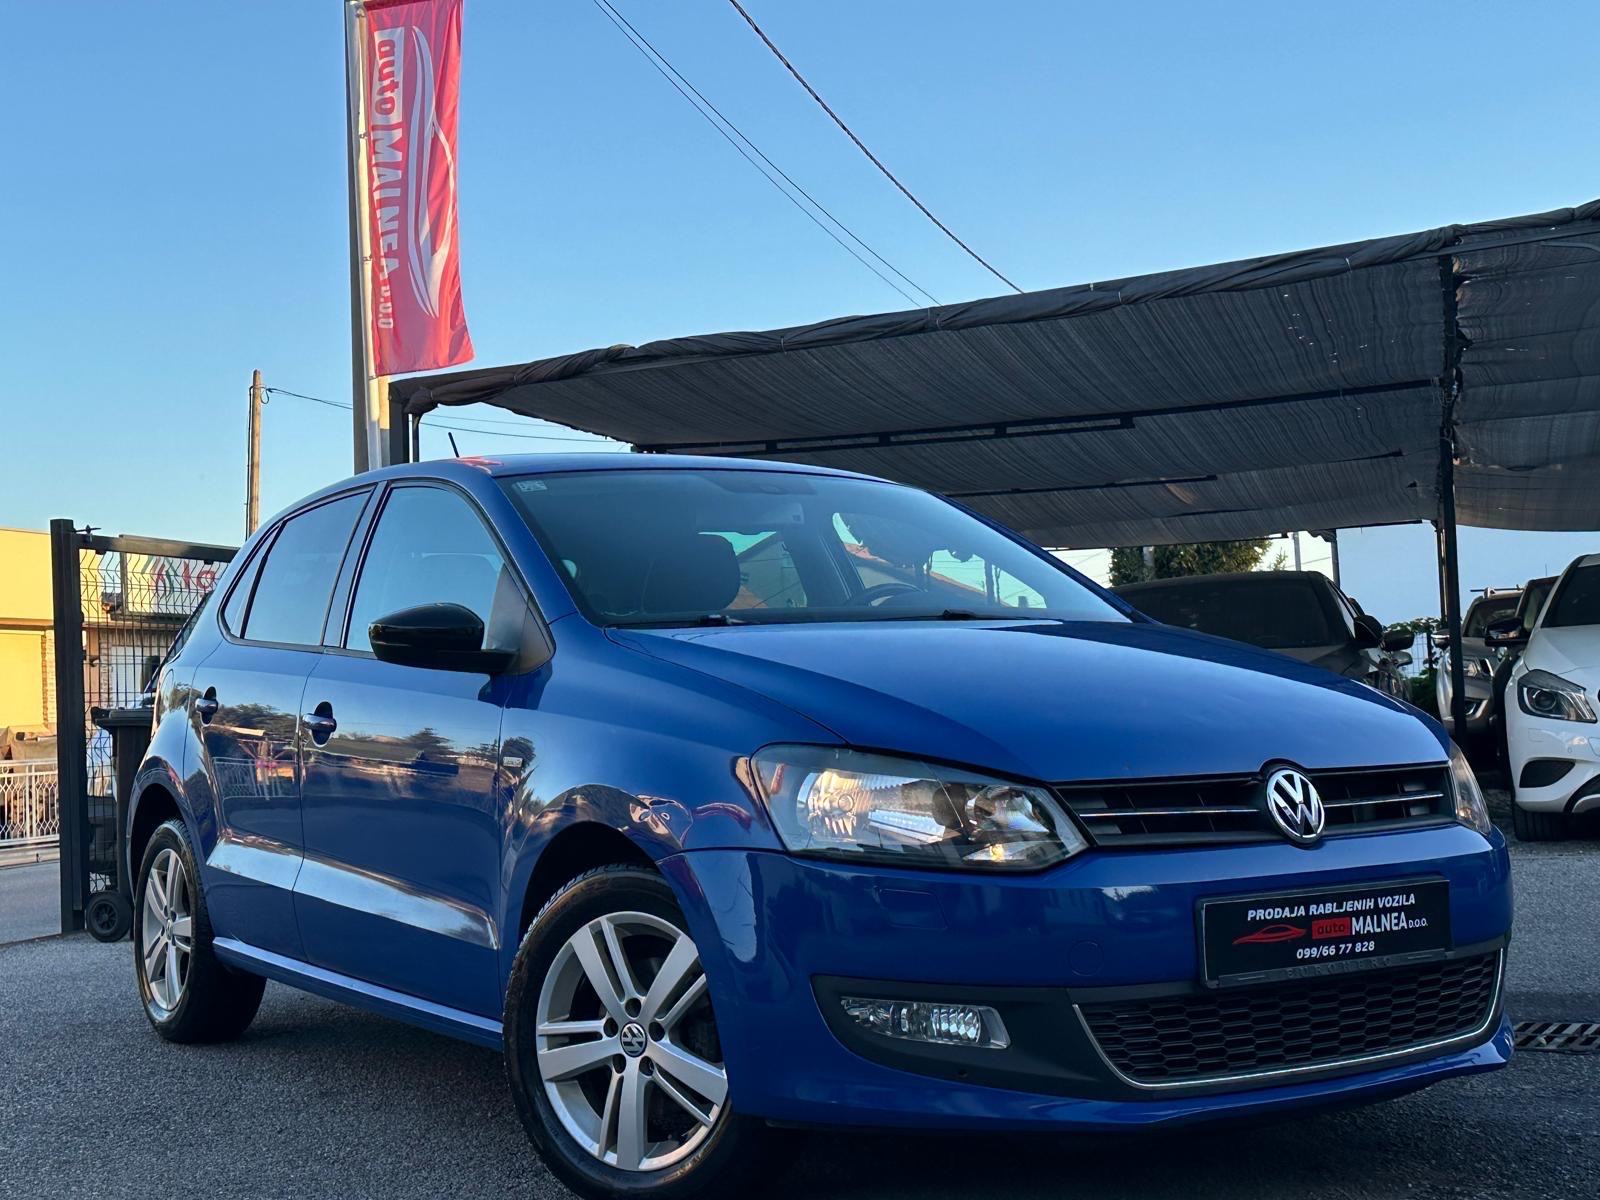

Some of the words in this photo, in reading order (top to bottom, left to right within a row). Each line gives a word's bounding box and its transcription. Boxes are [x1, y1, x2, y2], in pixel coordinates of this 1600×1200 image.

[375, 39, 399, 116] auto
[1247, 905, 1306, 921] PRODAJA
[1309, 897, 1375, 916] RABLJENIH
[1377, 893, 1416, 909] VOZILA
[1317, 923, 1346, 936] auto
[1351, 911, 1408, 936] MALNEA
[1296, 945, 1336, 960] 099/66
[1338, 943, 1353, 955] 77
[1355, 940, 1375, 953] 828
